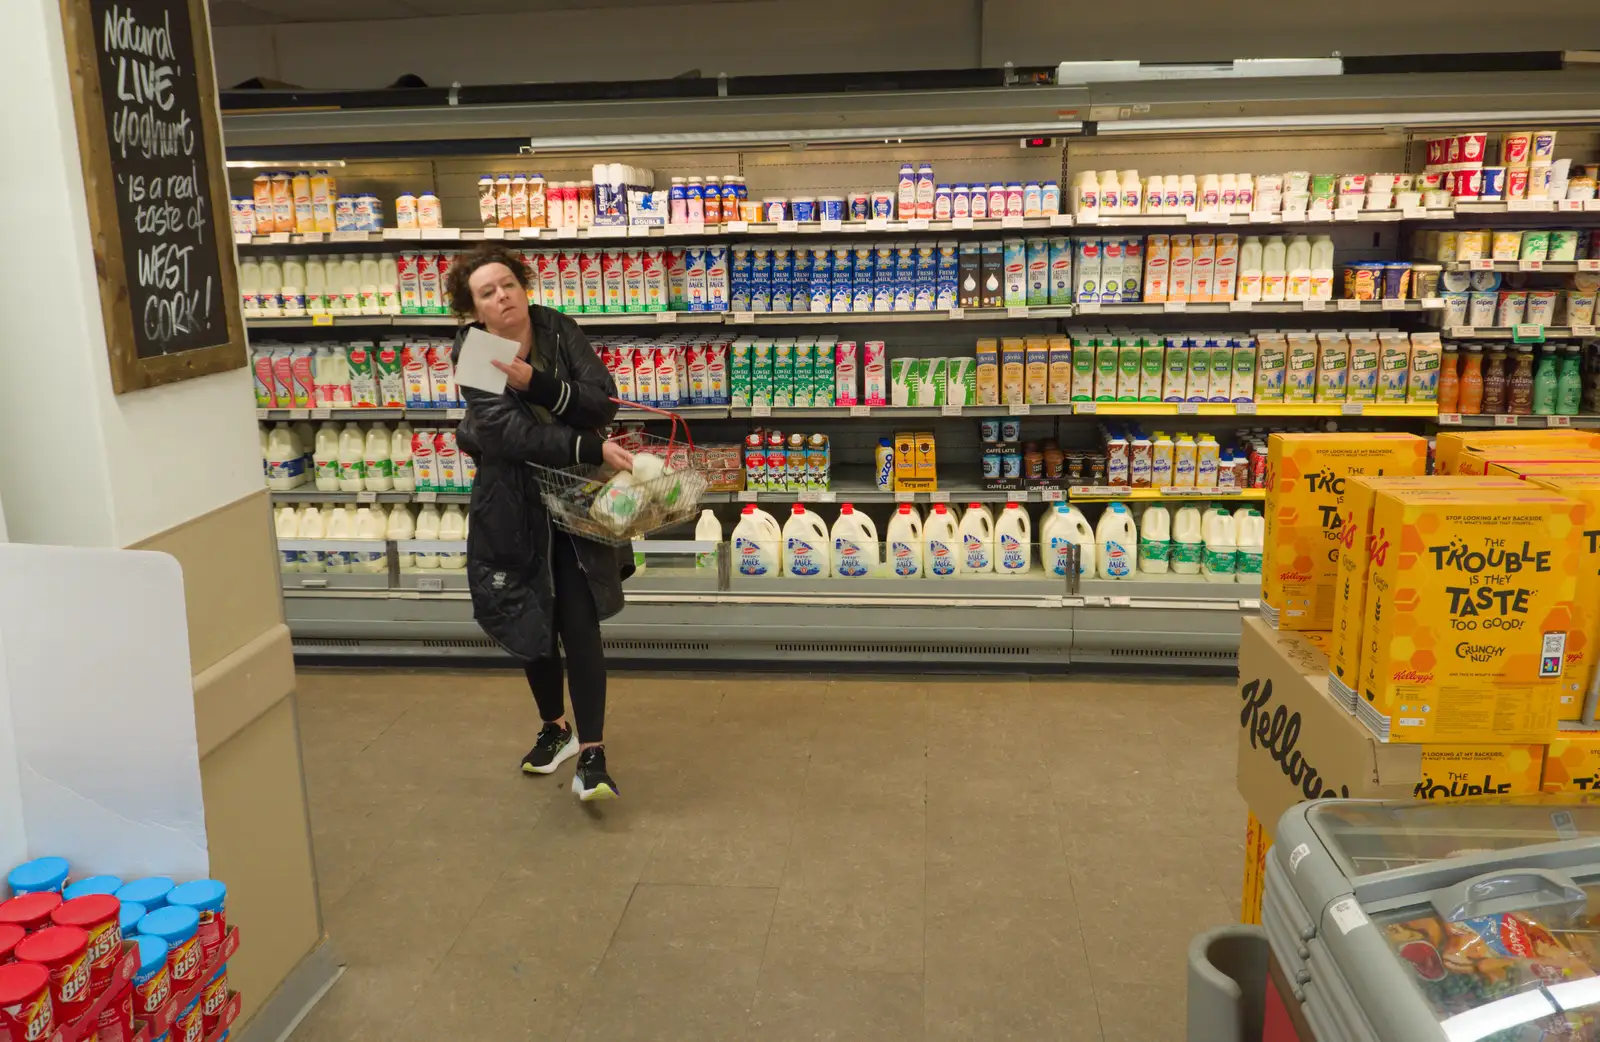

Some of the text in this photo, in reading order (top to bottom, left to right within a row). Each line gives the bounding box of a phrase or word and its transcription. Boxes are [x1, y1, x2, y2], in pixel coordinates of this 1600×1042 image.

[104, 4, 176, 60] Natural
[150, 177, 162, 200] a
[167, 160, 199, 199] real
[135, 196, 206, 245] taste of
[138, 243, 194, 294] WEST
[908, 371, 920, 391] milk
[935, 371, 946, 391] milk
[965, 370, 976, 391] milk
[879, 454, 892, 485] YAZOO
[1485, 538, 1505, 547] THE
[1429, 540, 1551, 573] TROUBLE
[1280, 571, 1313, 582] Kellogg's
[1470, 574, 1512, 585] IS THEY
[1446, 586, 1530, 617] TASTE
[1450, 617, 1526, 630] TOO GOOD!
[1456, 642, 1506, 658] CRUNCHY
[1393, 670, 1434, 684] Kellogg's
[1414, 775, 1511, 799] ROUBLE
[1448, 772, 1469, 781] THE
[28, 1006, 51, 1042] BIS
